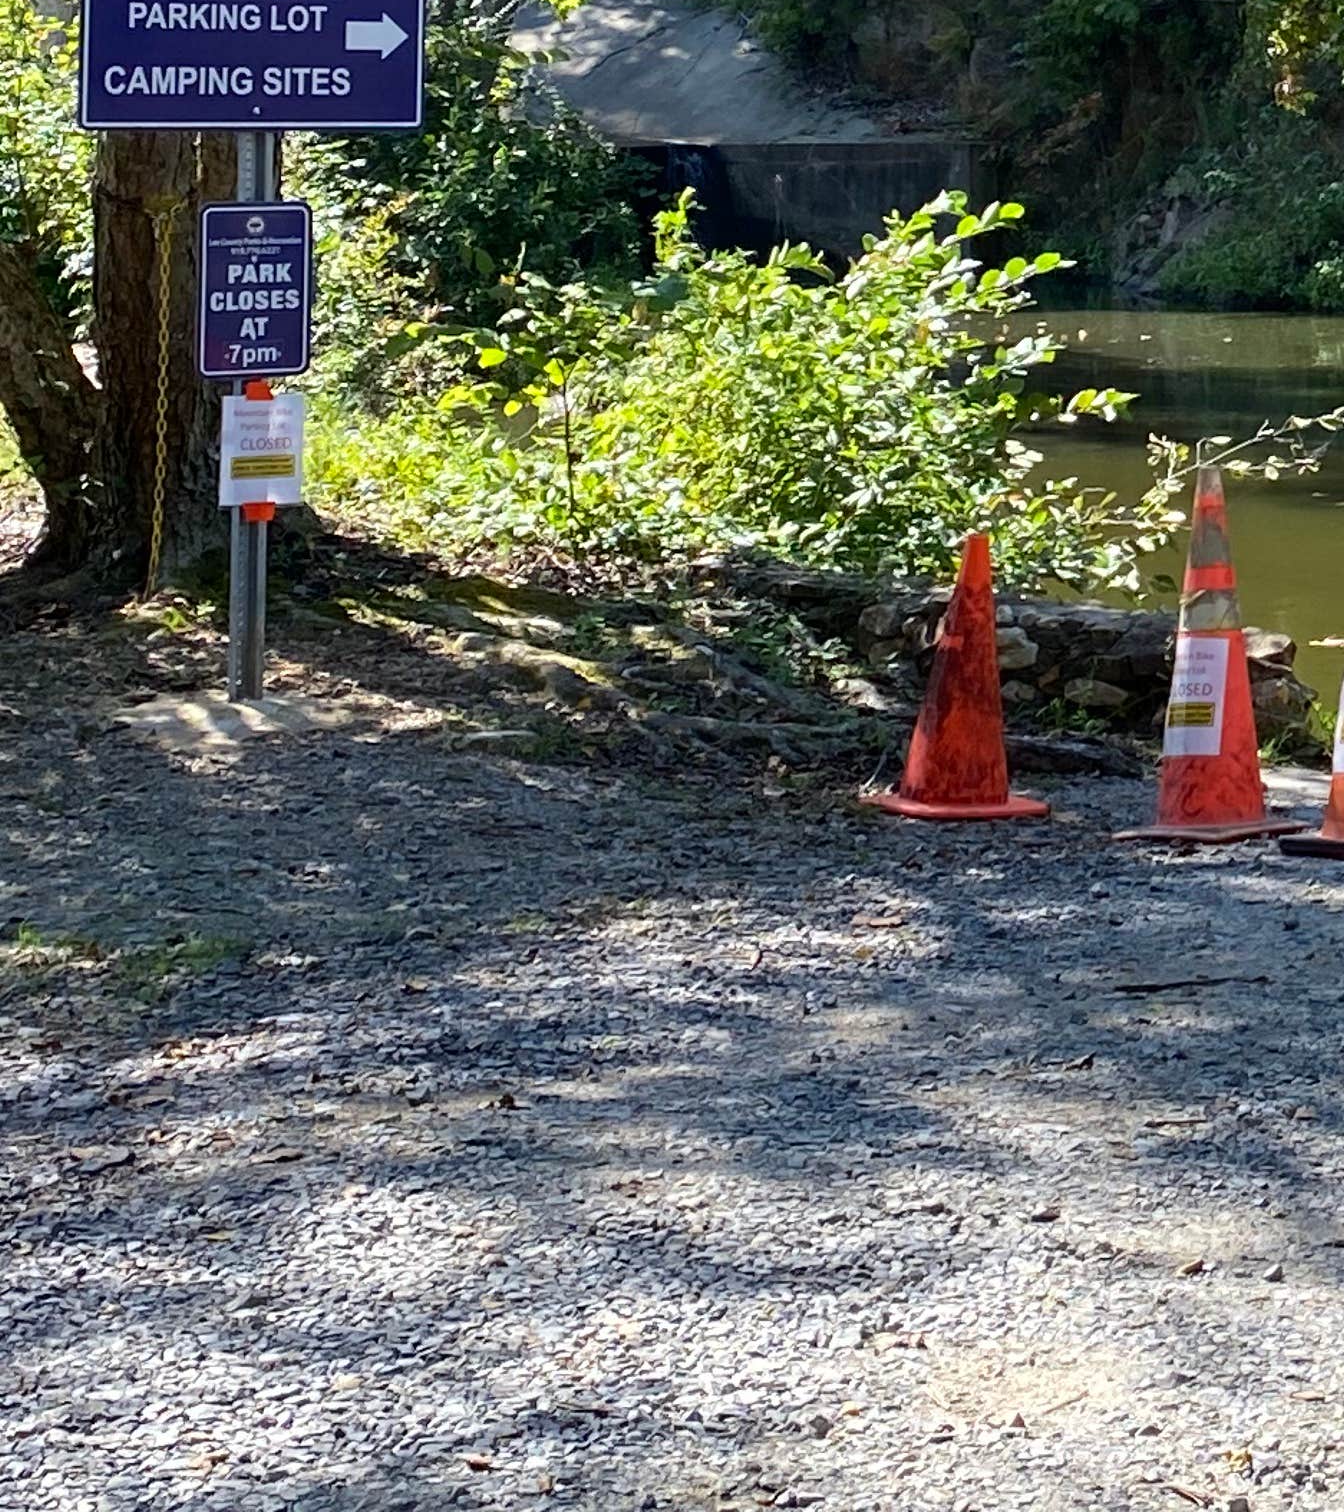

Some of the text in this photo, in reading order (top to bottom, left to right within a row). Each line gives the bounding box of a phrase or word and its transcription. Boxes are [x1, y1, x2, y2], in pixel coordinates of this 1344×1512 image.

[128, 1, 328, 32] PARKING LOT
[104, 65, 351, 96] CAMPING SITES
[227, 263, 292, 284] PARK
[210, 290, 300, 312] CLOSES
[240, 317, 269, 339] AT
[228, 345, 278, 368] 7pm
[240, 437, 292, 451] CLOSED
